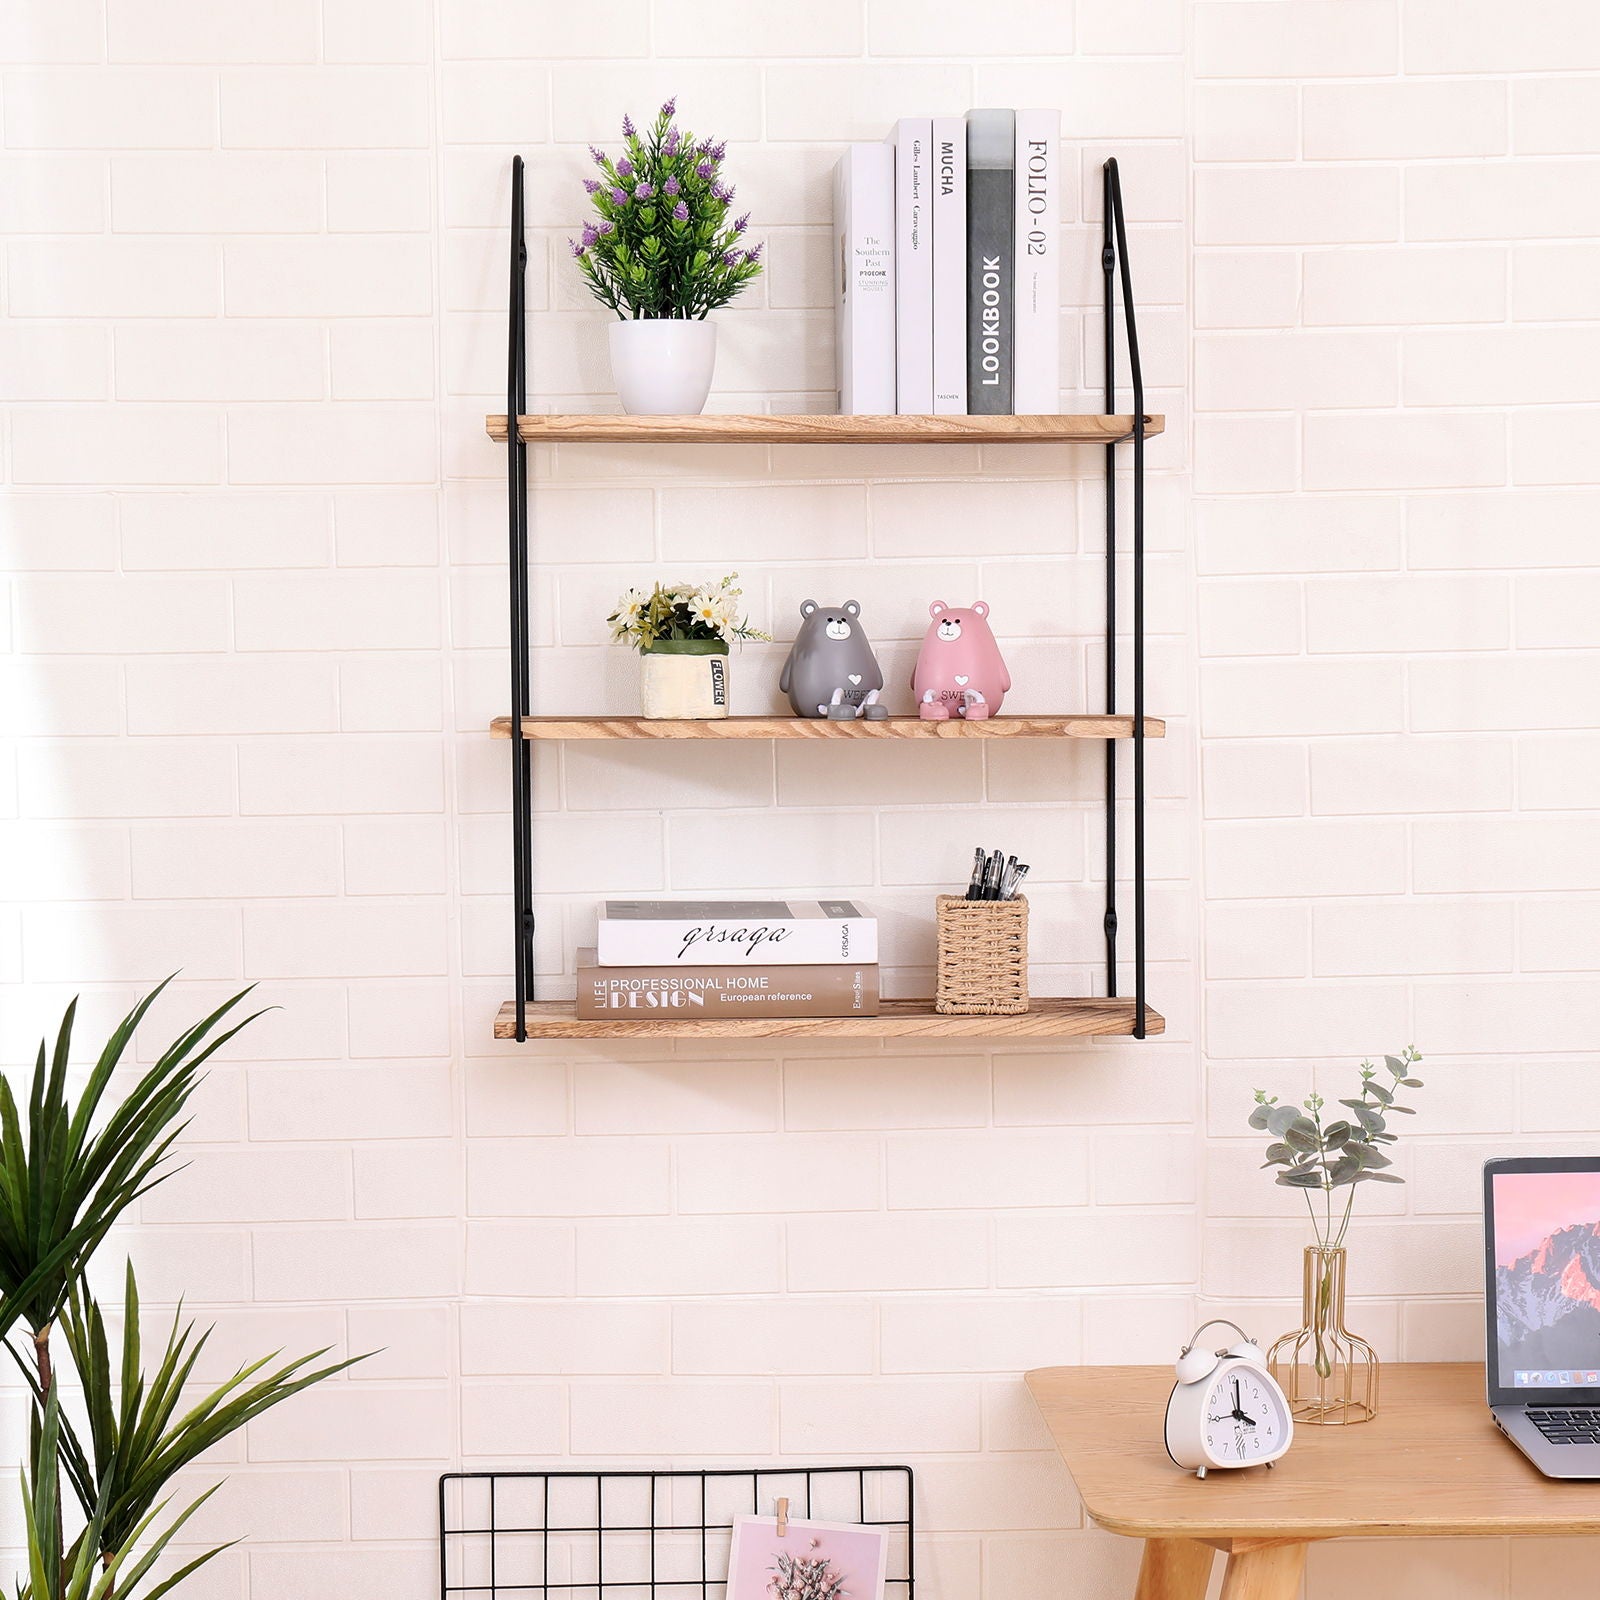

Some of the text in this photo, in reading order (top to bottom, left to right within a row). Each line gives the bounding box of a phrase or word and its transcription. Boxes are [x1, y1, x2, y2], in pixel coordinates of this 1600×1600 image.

[941, 142, 954, 196] MUCHA
[911, 140, 921, 250] Gilles Lambert Caravaggio
[864, 237, 881, 245] The
[855, 247, 891, 256] Southern
[865, 258, 881, 267] Past
[982, 255, 1000, 385] LOOKBOOK
[712, 661, 725, 704] FLOWER
[610, 977, 769, 991] PROFESSIONAL HOME
[594, 980, 606, 1009] LIFE
[610, 990, 704, 1009] DESIGN
[720, 992, 813, 1003] European reference
[1227, 1374, 1237, 1385] 12
[1217, 1384, 1224, 1394] 11
[1252, 1388, 1259, 1399] 2
[1261, 1403, 1269, 1415] 3
[1266, 1426, 1272, 1435] 4
[1207, 1435, 1214, 1447] 8
[1254, 1437, 1260, 1449] 5
[1223, 1443, 1228, 1455] 7
